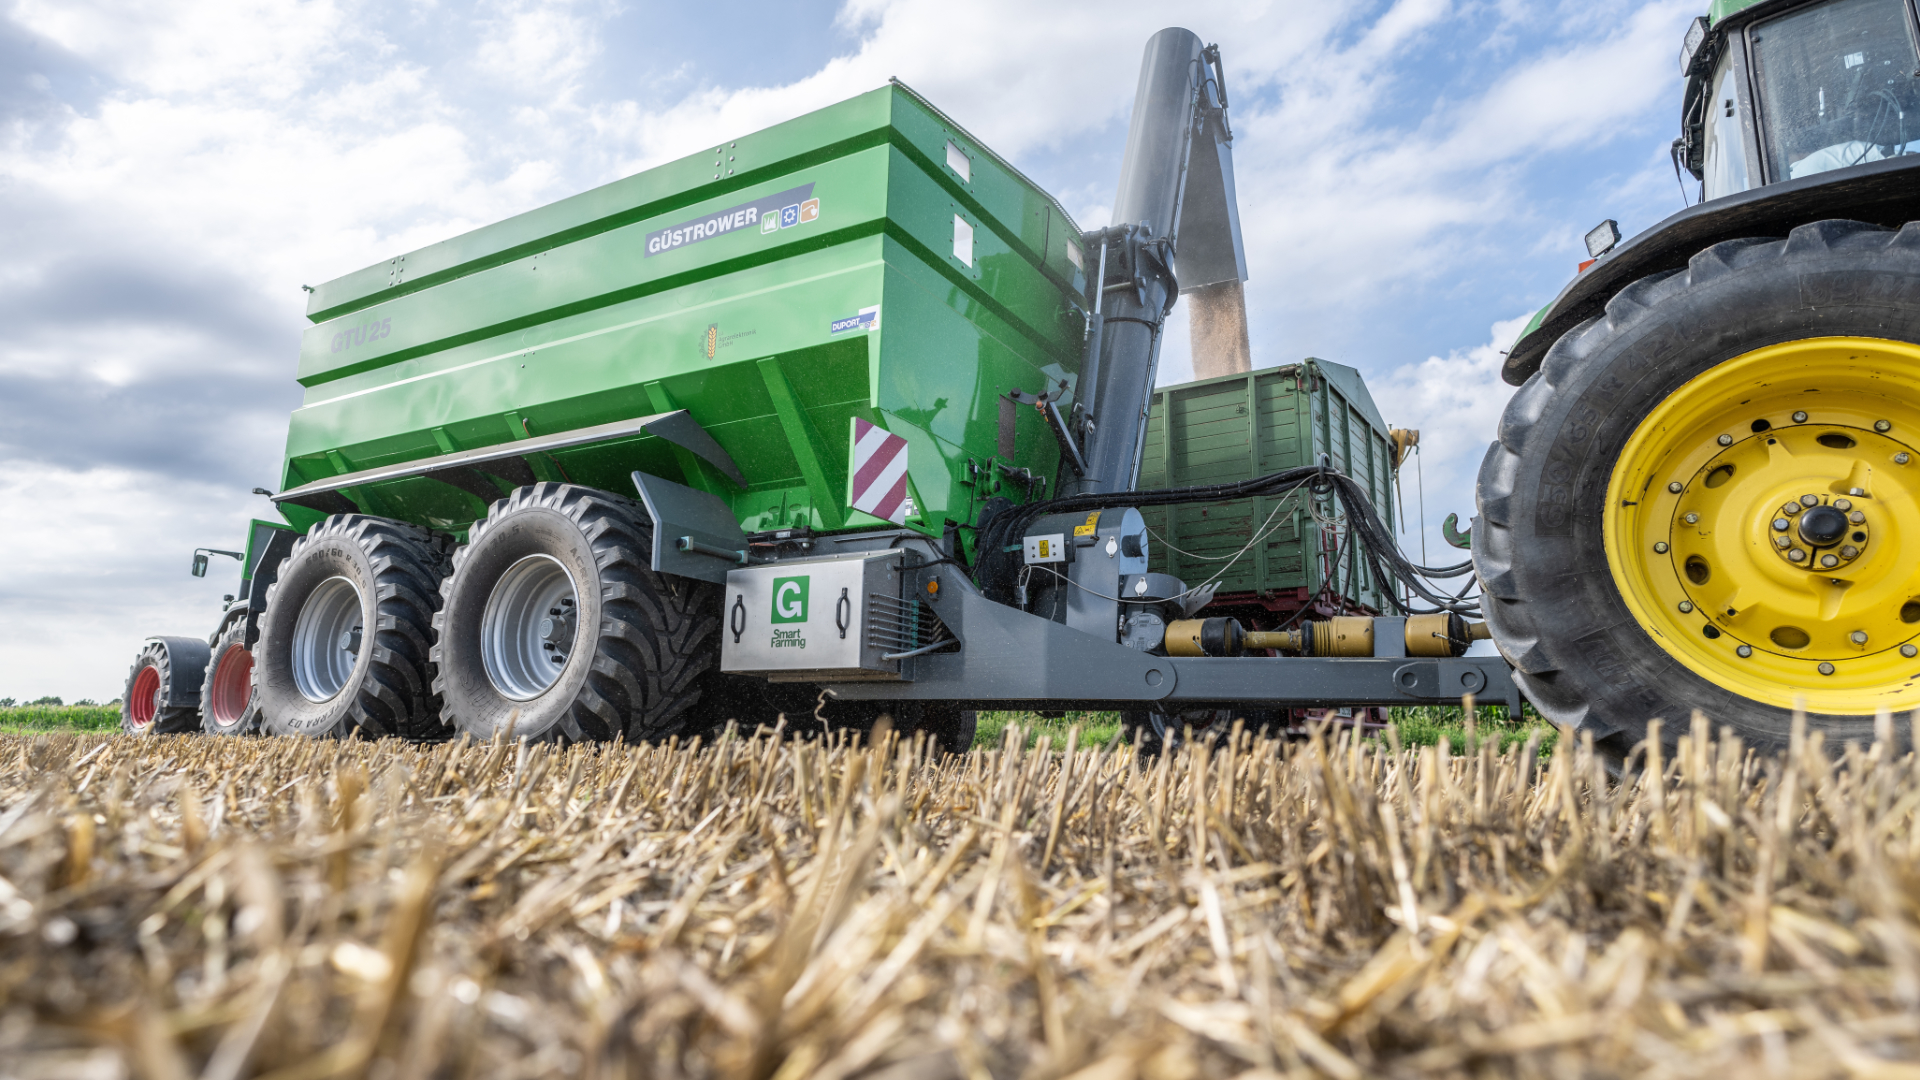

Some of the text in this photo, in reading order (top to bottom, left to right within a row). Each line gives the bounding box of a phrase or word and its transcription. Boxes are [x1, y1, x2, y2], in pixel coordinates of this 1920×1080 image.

[648, 207, 758, 253] GÜSTROWER
[331, 317, 392, 354] GTU 25
[832, 318, 860, 331] DUPORT
[776, 581, 802, 618] G
[770, 637, 806, 649] Farming
[773, 628, 801, 639] Smart
